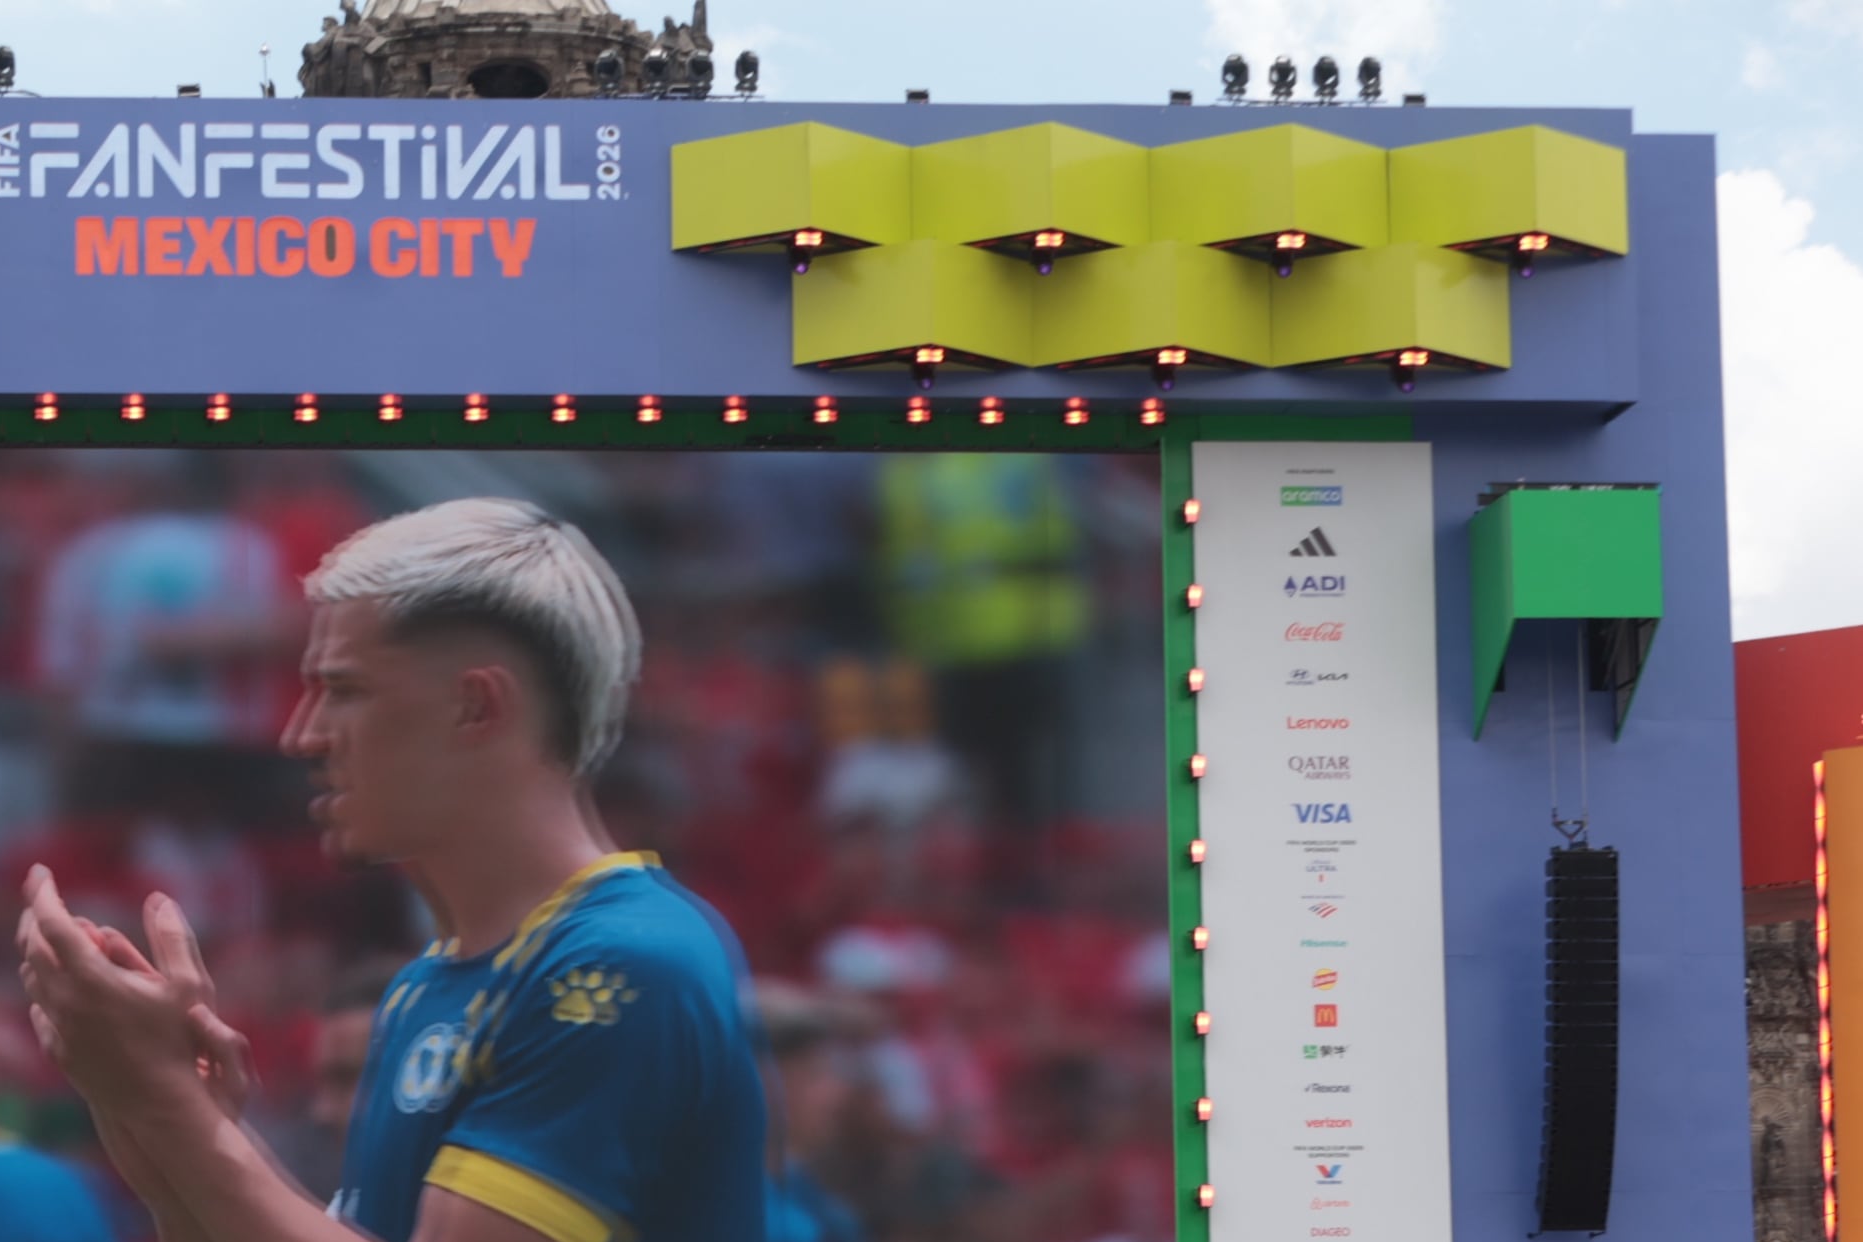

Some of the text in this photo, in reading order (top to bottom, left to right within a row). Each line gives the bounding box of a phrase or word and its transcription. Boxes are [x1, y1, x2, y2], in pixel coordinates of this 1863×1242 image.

[596, 125, 621, 200] 2026
[75, 216, 536, 277] MEXICO CITY
[1282, 491, 1340, 501] aramco
[1300, 575, 1346, 591] ADI
[1286, 717, 1350, 729] Lenovo
[1288, 756, 1350, 774] QATAR
[1292, 803, 1352, 823] VISA
[1306, 1118, 1353, 1129] verizon
[1310, 1227, 1351, 1238] DIAGEO
